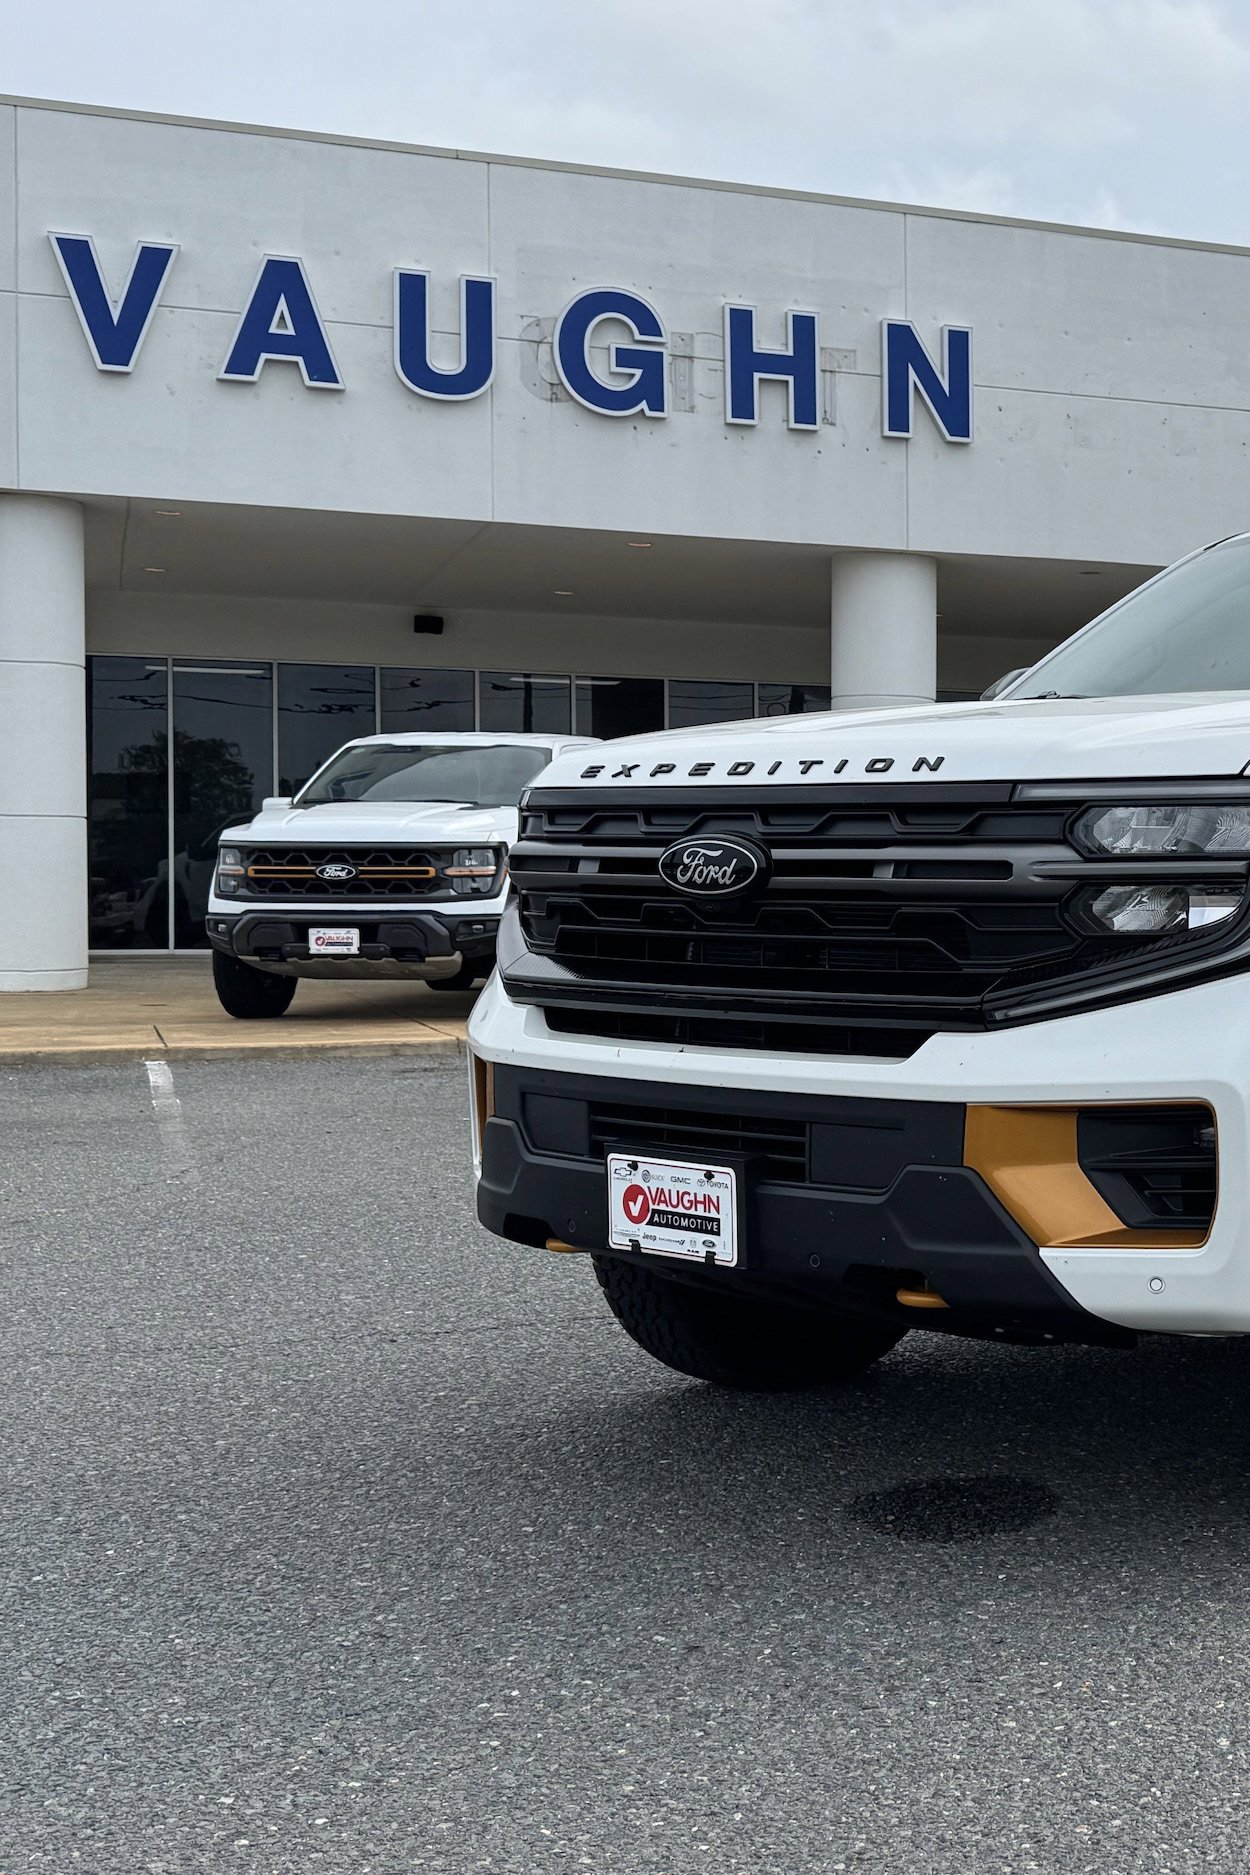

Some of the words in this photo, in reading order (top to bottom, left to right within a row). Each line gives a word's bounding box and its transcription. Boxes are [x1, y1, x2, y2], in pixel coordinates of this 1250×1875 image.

[47, 231, 975, 444] VAUGHN
[580, 756, 945, 779] EXPEDITION
[323, 866, 348, 877] Ford
[676, 847, 737, 886] Ford
[670, 1175, 691, 1185] GMC
[706, 1179, 729, 1189] TOYOTA
[646, 1186, 720, 1215] VAUGHN
[652, 1212, 719, 1232] AUTOMOTIVE
[642, 1232, 657, 1242] Jeep
